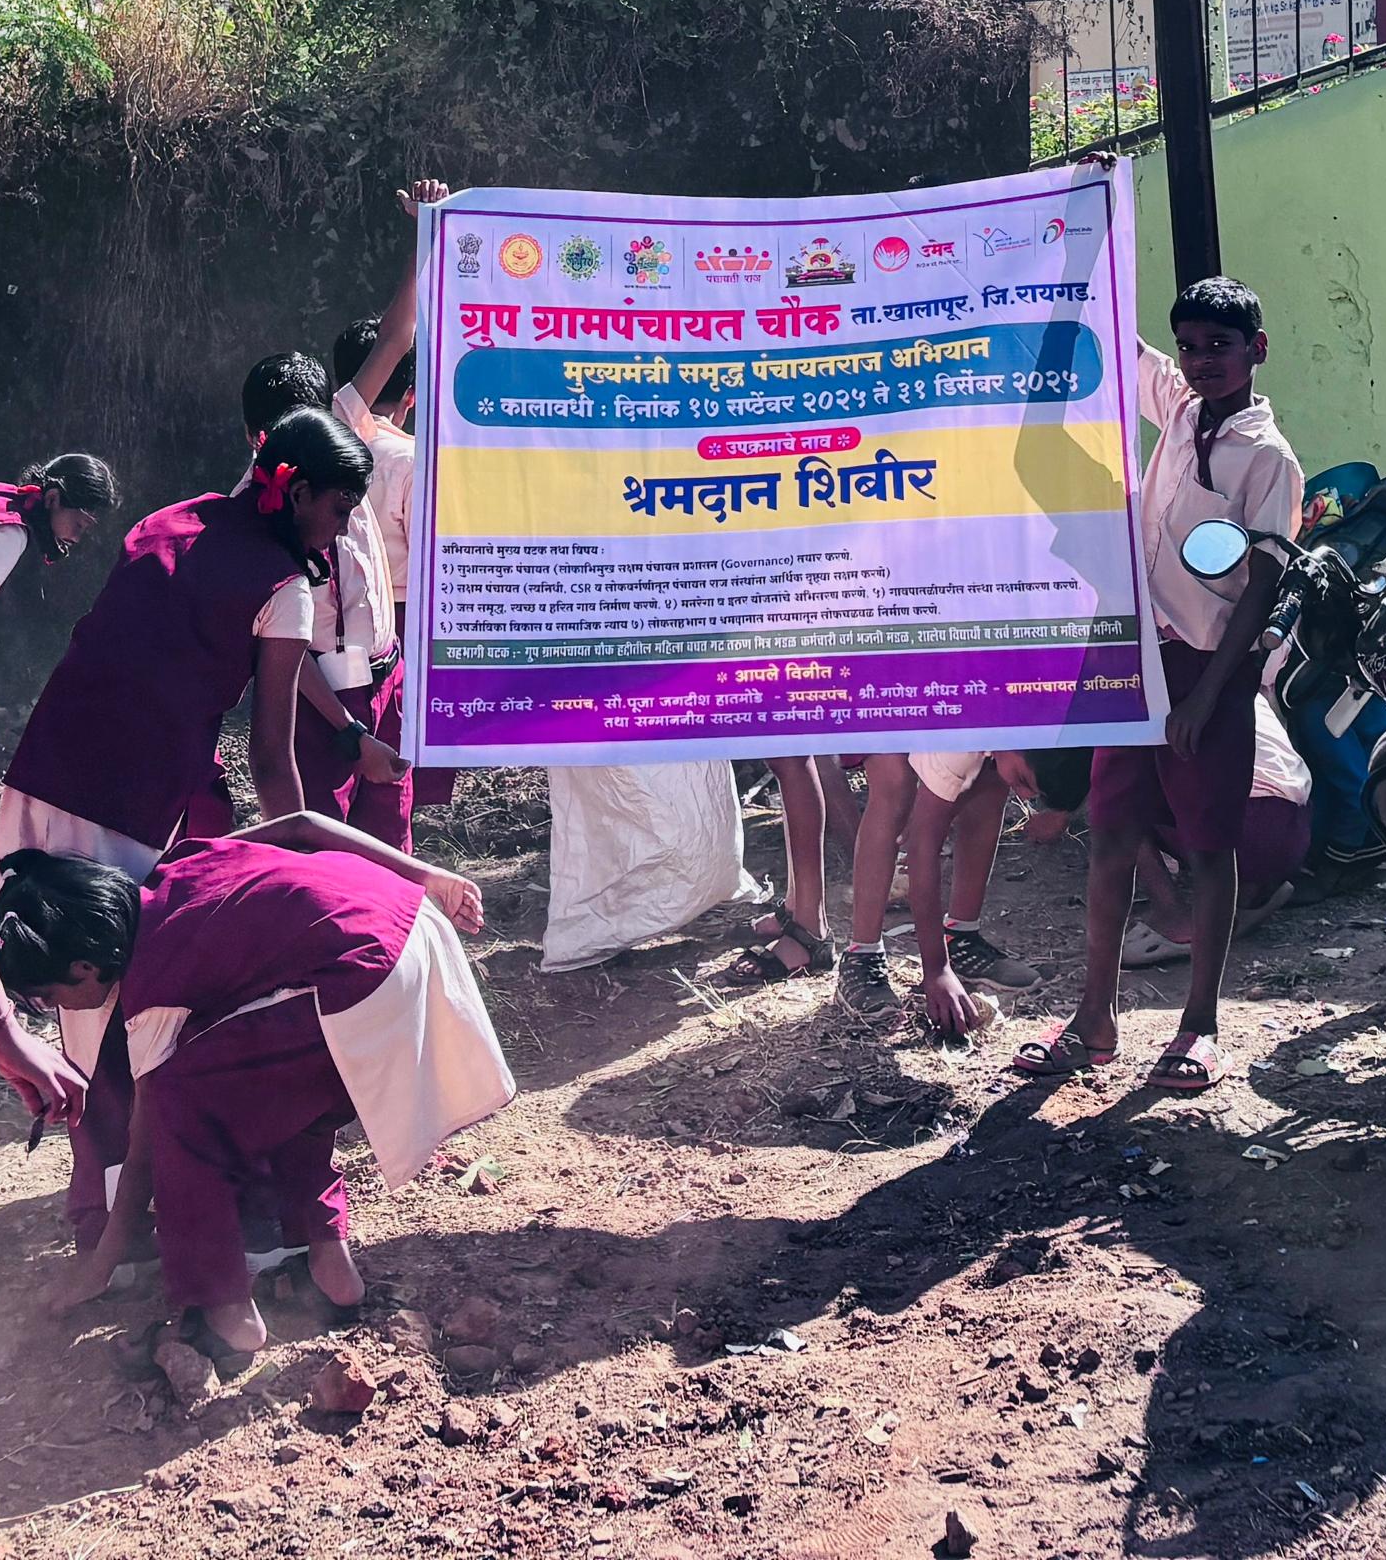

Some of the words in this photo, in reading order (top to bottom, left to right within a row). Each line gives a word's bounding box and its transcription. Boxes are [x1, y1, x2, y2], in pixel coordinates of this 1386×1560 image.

[459, 303, 521, 349] ग्रुप
[532, 297, 745, 342] ग्रामपंचायत
[756, 295, 842, 339] चौक
[564, 353, 671, 394] मुख्यमंत्री
[678, 361, 745, 393] समृद्ध
[752, 352, 883, 382] पंचायतराज
[889, 336, 991, 369] अभियान
[500, 395, 594, 419] कालावधी
[614, 394, 681, 422] दिनांक
[688, 399, 719, 418] १७
[726, 391, 796, 418] सप्टेंबर
[802, 388, 866, 414] २०२५
[873, 380, 890, 405] ते
[897, 379, 926, 405] ३१
[1012, 369, 1078, 394] २०२५
[725, 432, 795, 455] उपक्रमाचे
[800, 433, 833, 450] नाव
[622, 472, 781, 524] श्रमदान
[794, 448, 938, 509] शिबीर
[442, 543, 493, 555] अभियानाचे
[497, 545, 520, 558] मुख्य
[524, 546, 547, 555] घटक
[550, 545, 569, 555] तथा
[572, 543, 598, 555] विषय
[458, 564, 513, 577] सुशासनयुक्त
[516, 562, 550, 574] पंचायत
[618, 564, 643, 574] सक्षम
[647, 560, 679, 573] पंचायत
[683, 559, 718, 571] प्रशासन
[721, 554, 794, 572] (Governance)
[797, 551, 821, 562] तयार
[457, 584, 482, 594] सक्षम
[485, 581, 519, 594] पंचायत
[570, 583, 591, 593] CSR
[673, 578, 706, 589] पंचायत
[710, 579, 728, 588] राज
[769, 571, 803, 583] आर्थिक
[456, 619, 506, 632] उपजीविका
[509, 619, 541, 632] विकास
[556, 618, 601, 631] सामाजिक
[604, 620, 628, 630] न्याय
[877, 604, 909, 617] निर्माण
[457, 603, 474, 613] जल
[549, 600, 573, 613] हरित
[576, 602, 596, 611] गाव
[599, 599, 630, 611] निर्माण
[728, 595, 747, 606] इतर
[447, 645, 484, 659] सहभागी
[487, 646, 510, 658] घटक
[542, 643, 591, 658] ग्रामपंचायत
[594, 642, 614, 656] चौक
[655, 639, 683, 654] महिला
[800, 631, 836, 647] कर्मचारी
[918, 627, 946, 642] शालेय
[1060, 622, 1089, 637] महिला
[1093, 620, 1122, 635] भगिनी
[735, 663, 779, 683] आपले
[785, 661, 833, 681] विनीत
[431, 697, 454, 718] रितु
[459, 697, 495, 717] सुधिर
[551, 695, 598, 713] सरपंच,
[660, 691, 710, 708] जगदीश
[786, 685, 852, 703] उपसरपंच,
[923, 681, 959, 697] श्रीधर
[964, 680, 987, 695] मोरे
[1006, 677, 1077, 695] ग्रामपंचायत
[1083, 673, 1140, 691] अधिकारी
[603, 716, 629, 728] तथा
[711, 711, 752, 725] सदस्य
[772, 705, 824, 722] कर्मचारी
[856, 702, 928, 720] ग्रामपंचायत
[933, 700, 962, 716] चौक
